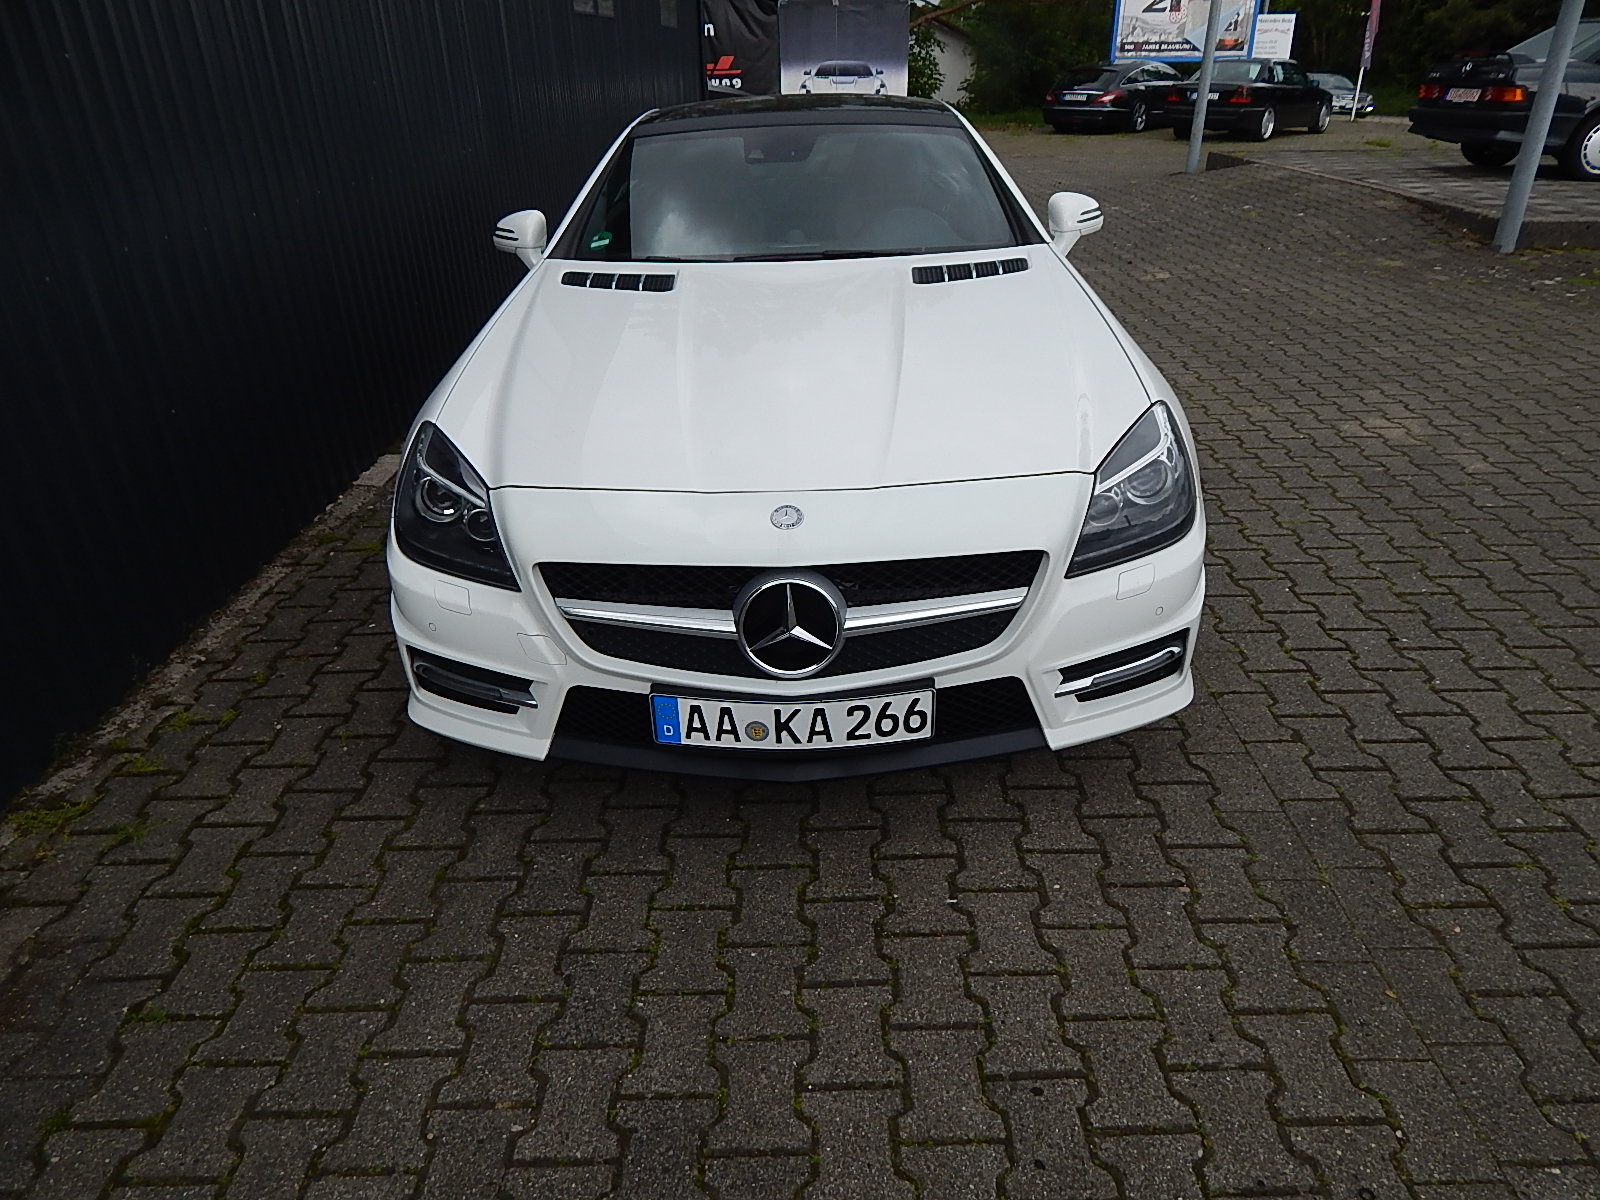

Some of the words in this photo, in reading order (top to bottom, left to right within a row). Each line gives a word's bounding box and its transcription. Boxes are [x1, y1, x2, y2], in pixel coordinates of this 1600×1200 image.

[663, 724, 674, 736] D
[685, 704, 741, 743] AA
[774, 707, 834, 744] KA
[846, 697, 928, 742] 266
